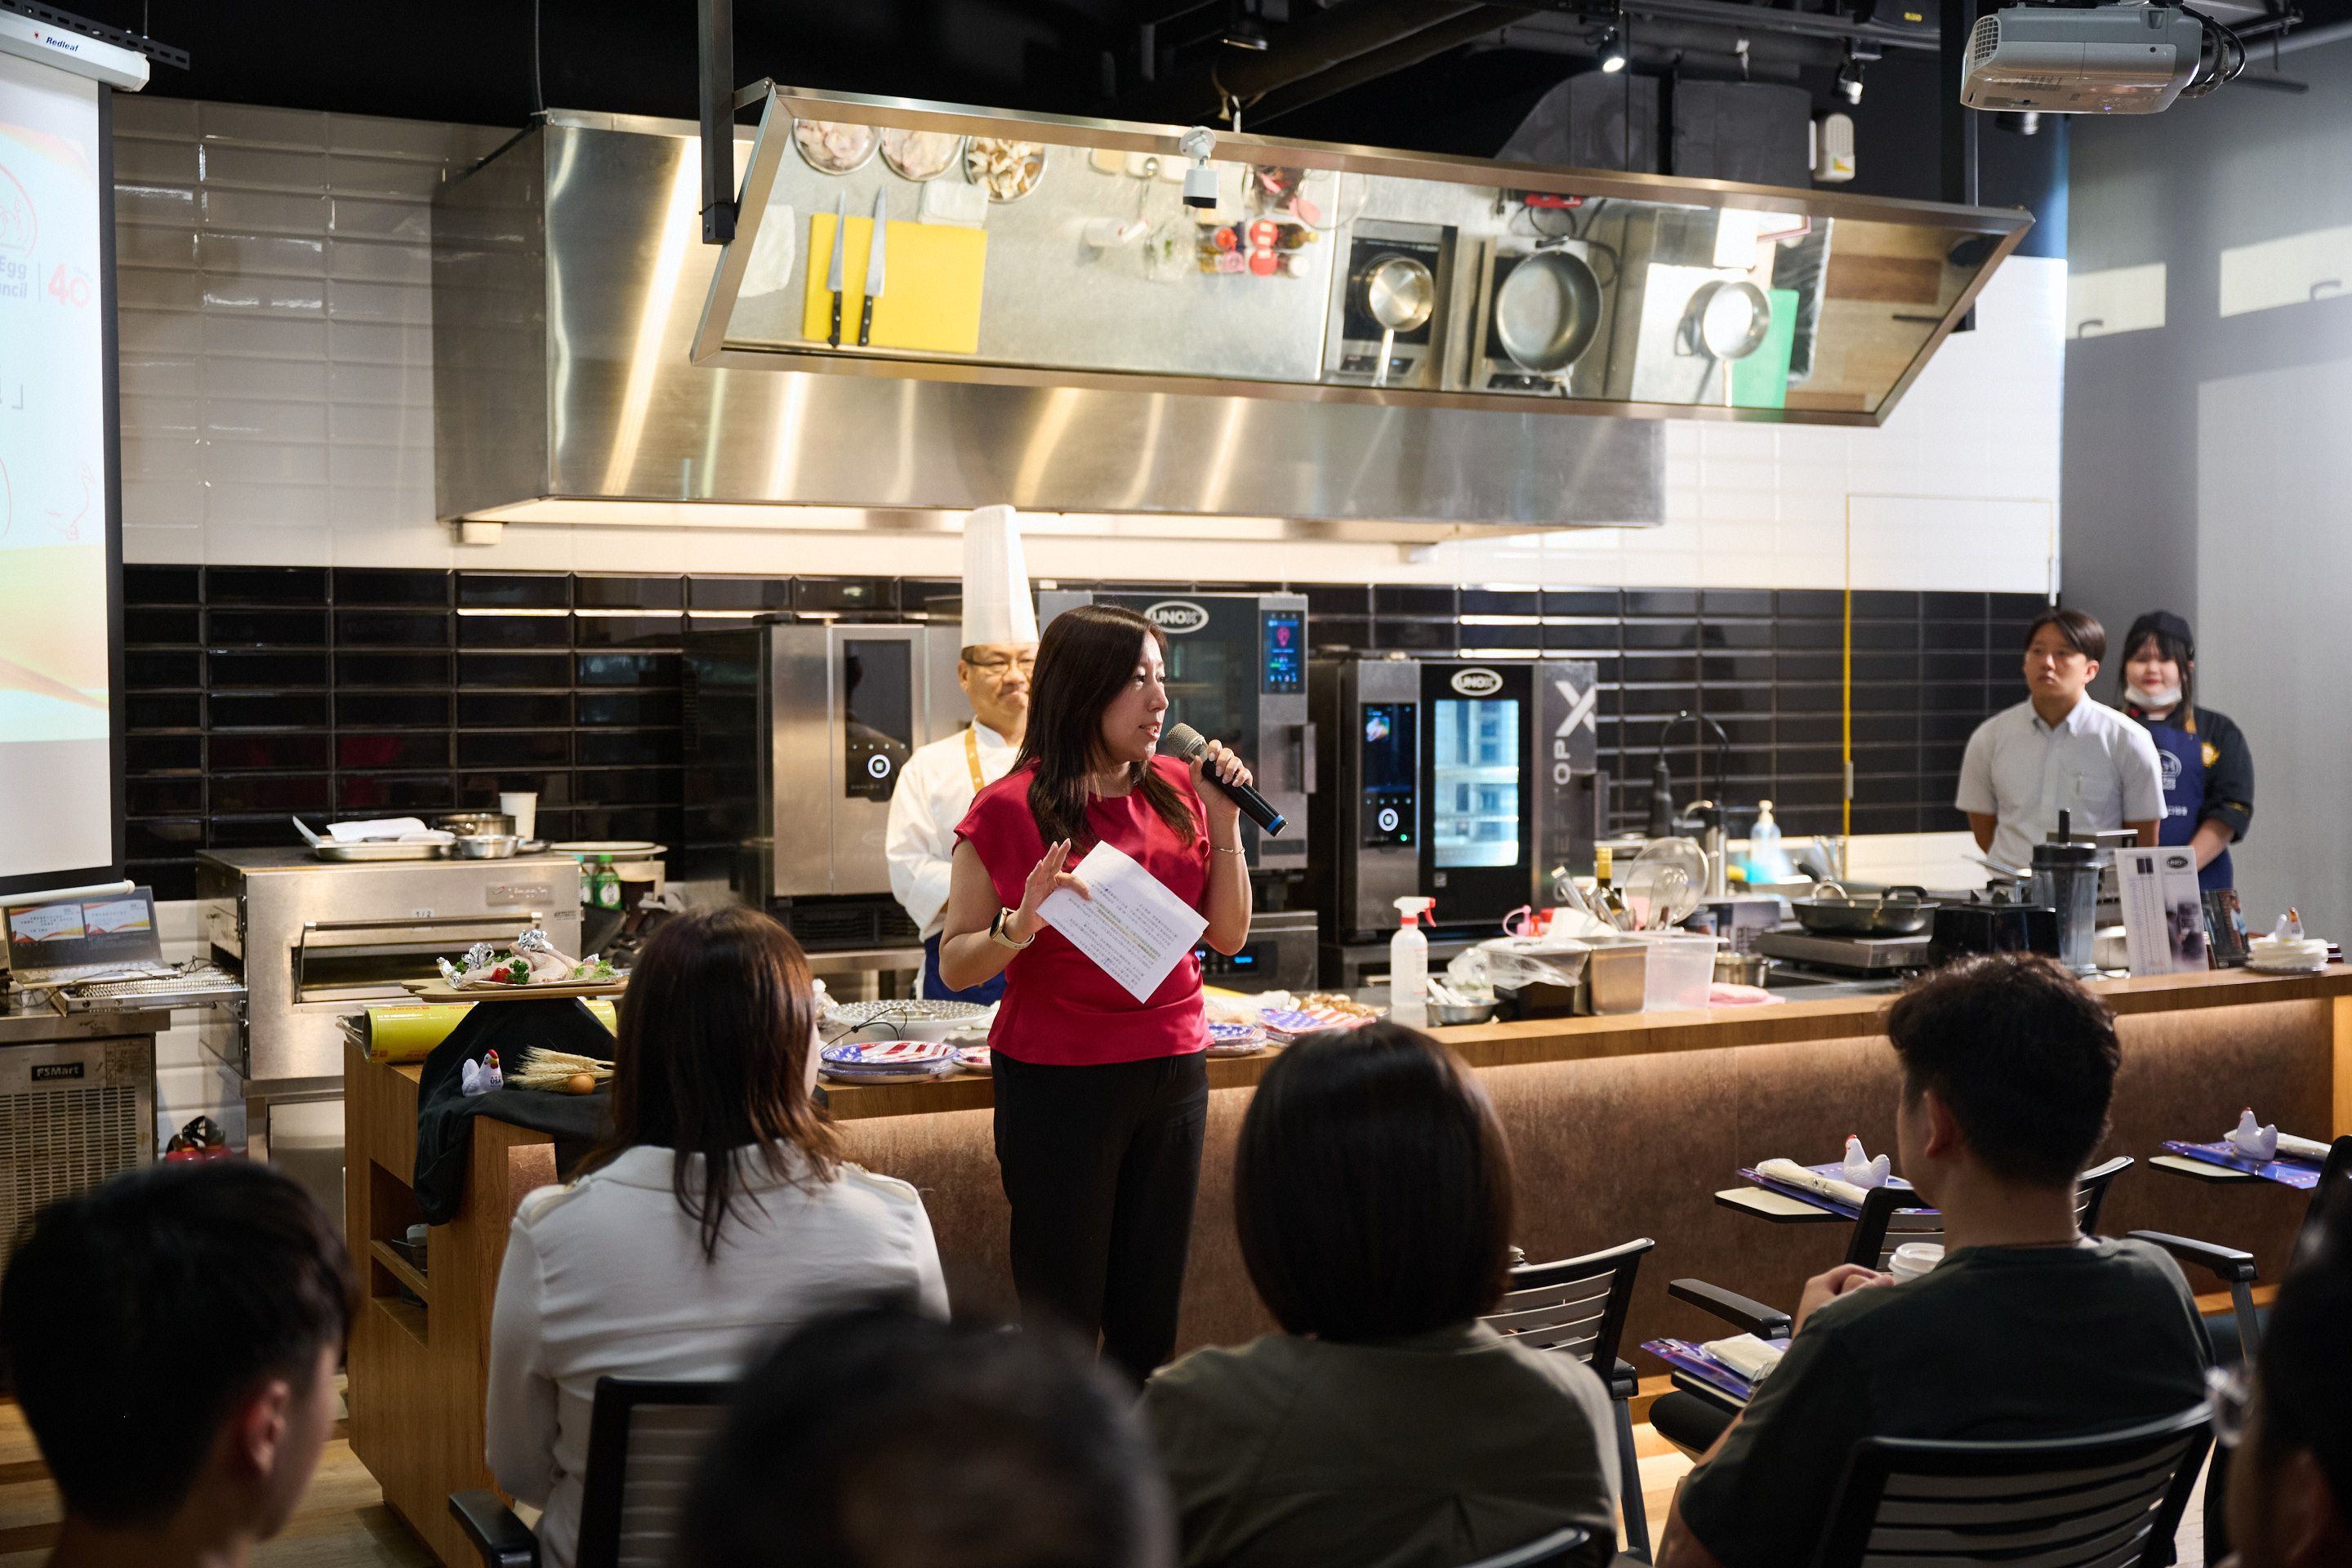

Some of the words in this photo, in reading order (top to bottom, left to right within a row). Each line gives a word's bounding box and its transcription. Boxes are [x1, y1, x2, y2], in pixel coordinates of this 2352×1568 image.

[0, 256, 27, 279] Egg
[0, 282, 28, 300] ncil
[48, 263, 90, 308] 40
[1152, 610, 1198, 625] UNOX
[37, 1066, 79, 1077] FSMart
